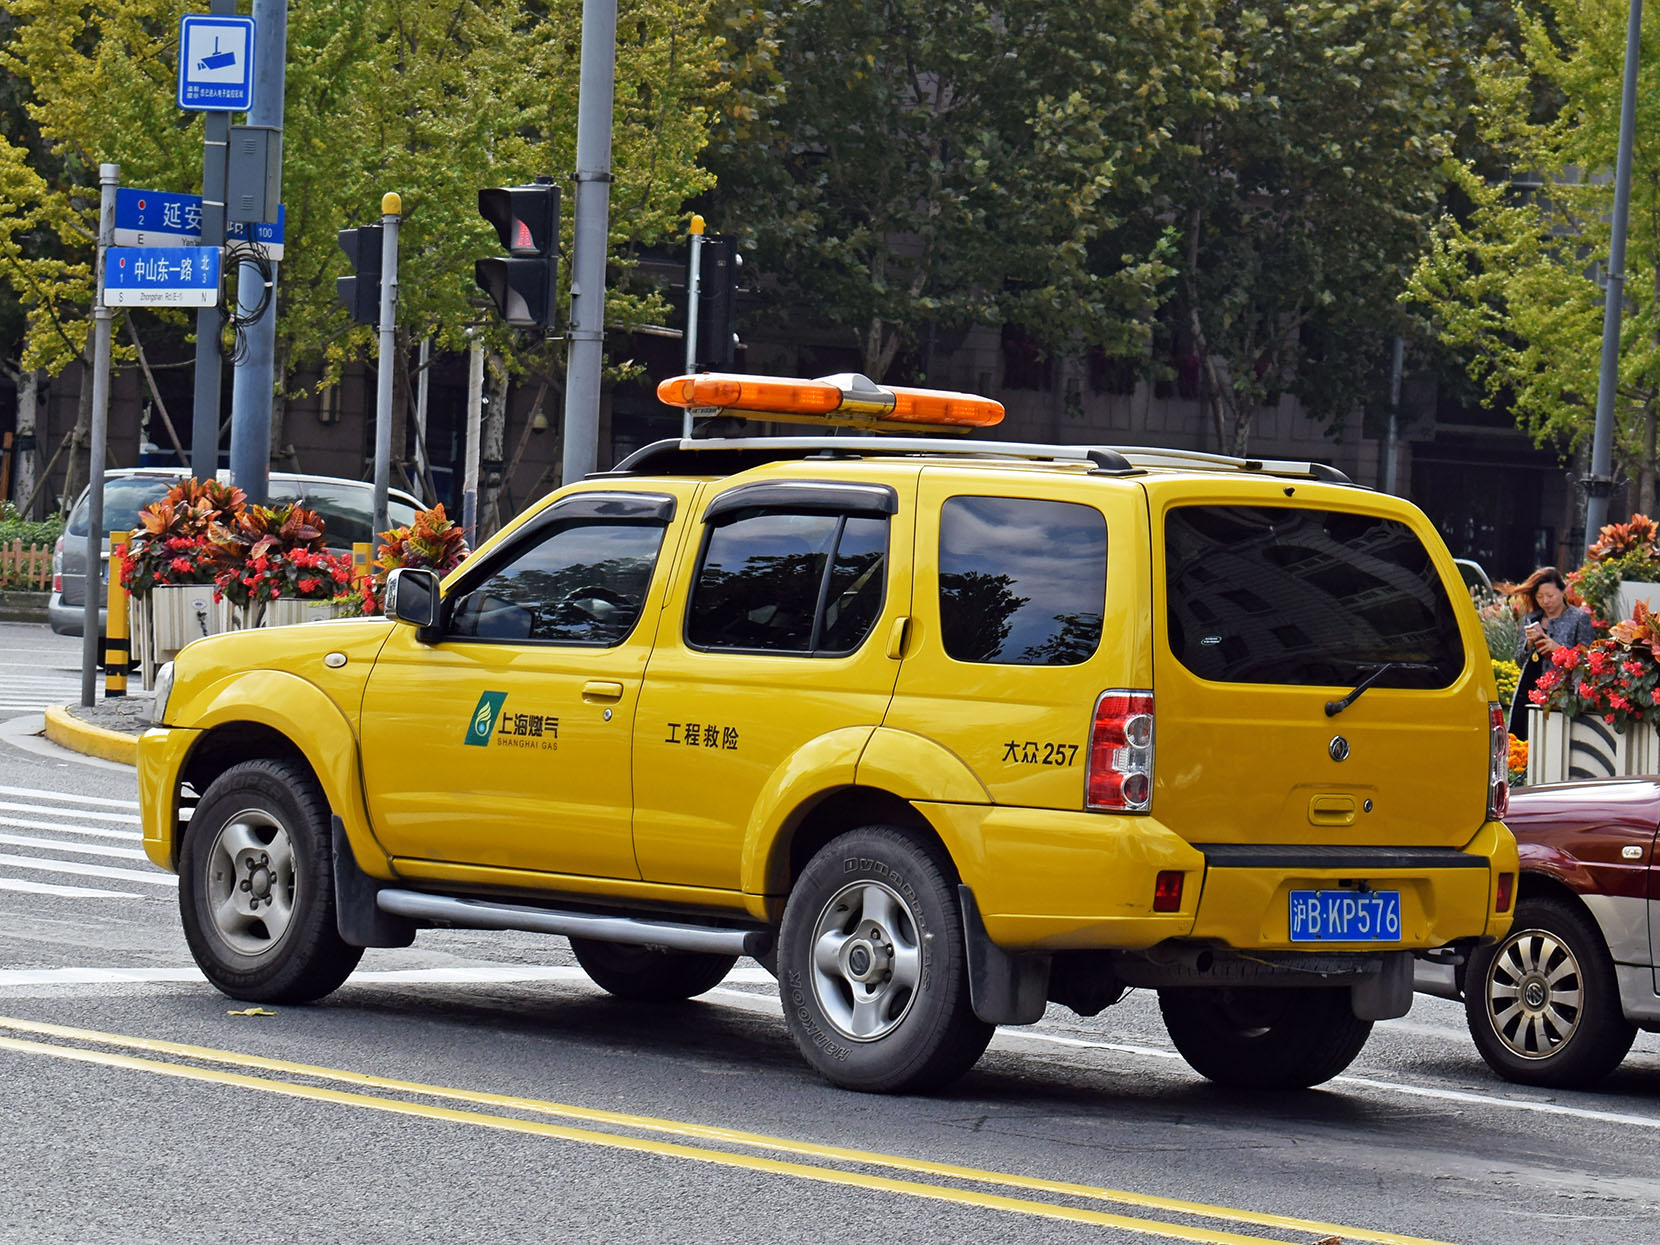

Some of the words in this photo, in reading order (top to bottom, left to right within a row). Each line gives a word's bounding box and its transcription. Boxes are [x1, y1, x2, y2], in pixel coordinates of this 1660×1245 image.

[138, 215, 145, 226] 2
[138, 233, 144, 245] E
[258, 227, 273, 239] 100
[201, 255, 209, 271] 北
[134, 257, 193, 282] 中山东一路
[202, 273, 207, 284] 3
[118, 291, 124, 303] S
[201, 292, 207, 303] N
[498, 711, 559, 739] 上海燃气
[665, 722, 739, 751] 工程救险
[497, 738, 539, 749] SHANGHAI
[541, 741, 558, 751] GAS
